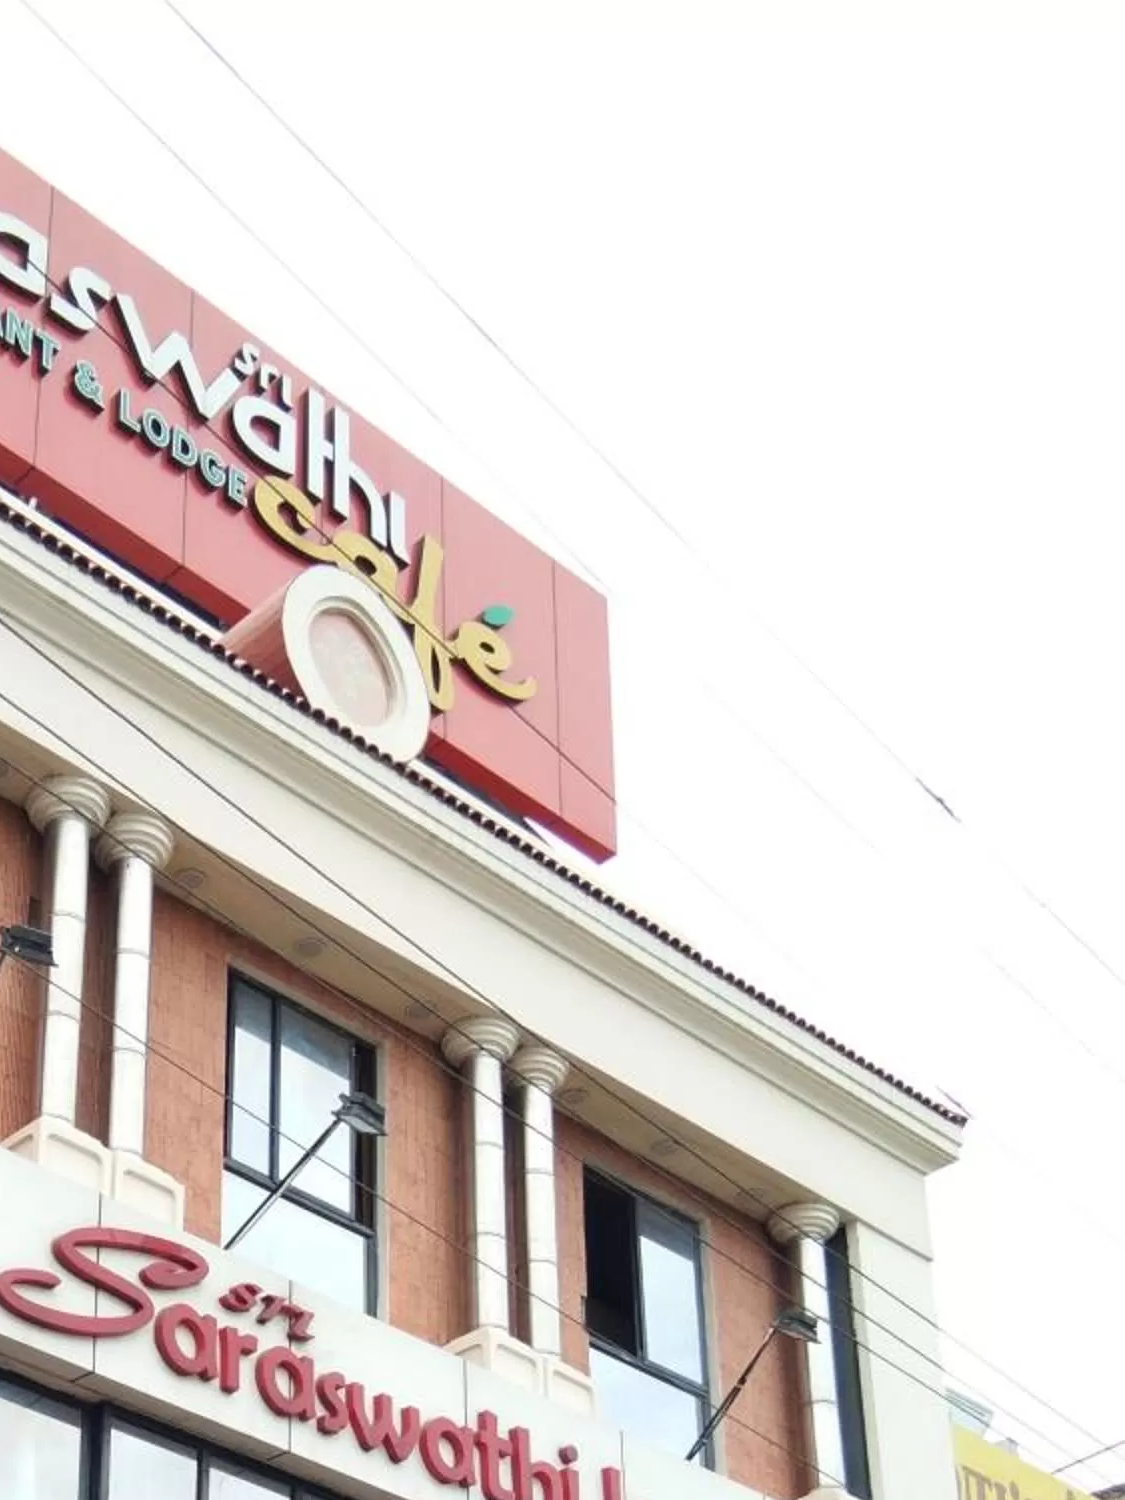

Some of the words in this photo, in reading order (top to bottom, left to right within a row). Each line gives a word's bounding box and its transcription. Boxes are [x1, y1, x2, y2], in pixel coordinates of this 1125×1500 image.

[74, 360, 105, 408] &
[119, 387, 248, 505] LODGE
[219, 1281, 315, 1342] sri
